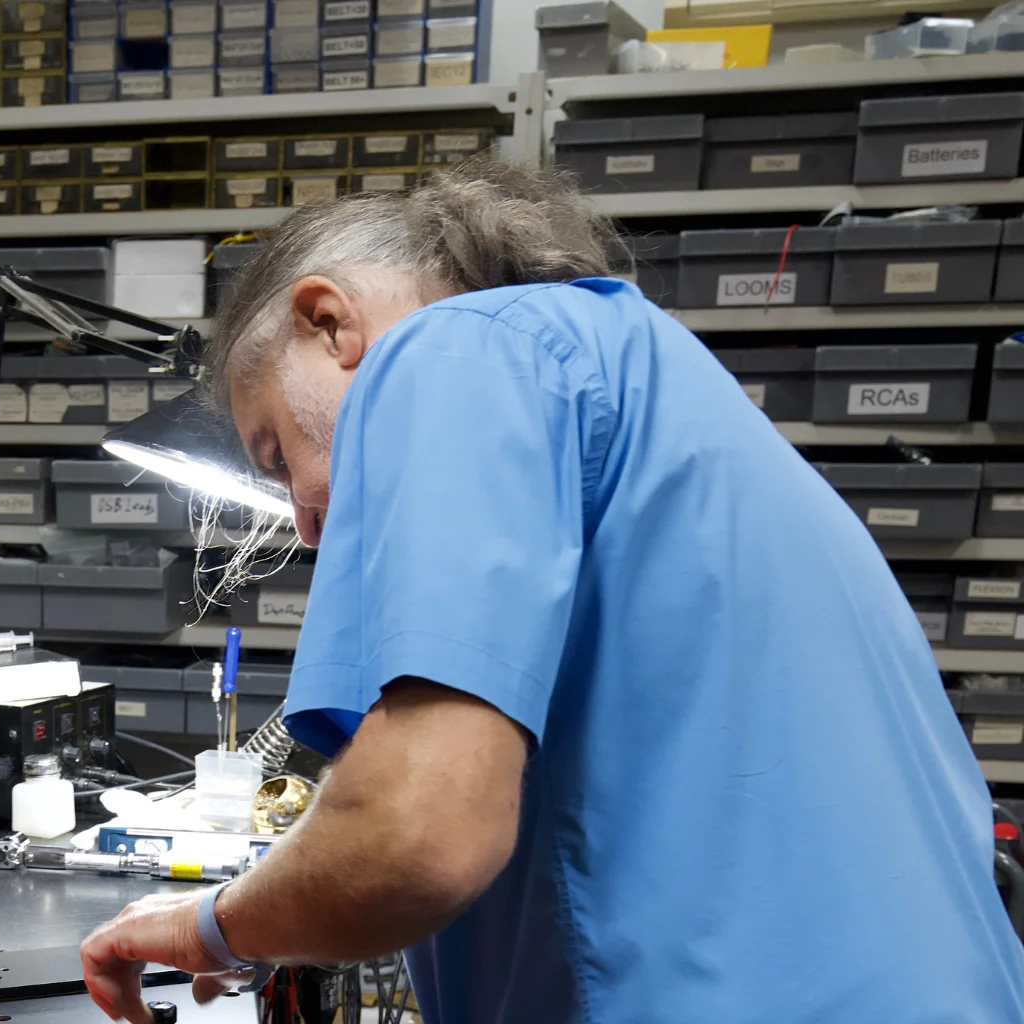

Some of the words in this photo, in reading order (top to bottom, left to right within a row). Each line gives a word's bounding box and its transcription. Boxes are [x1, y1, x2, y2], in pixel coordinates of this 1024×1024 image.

[908, 147, 980, 164] Batteries
[724, 279, 793, 297] LOOMS
[860, 388, 920, 406] RCAs
